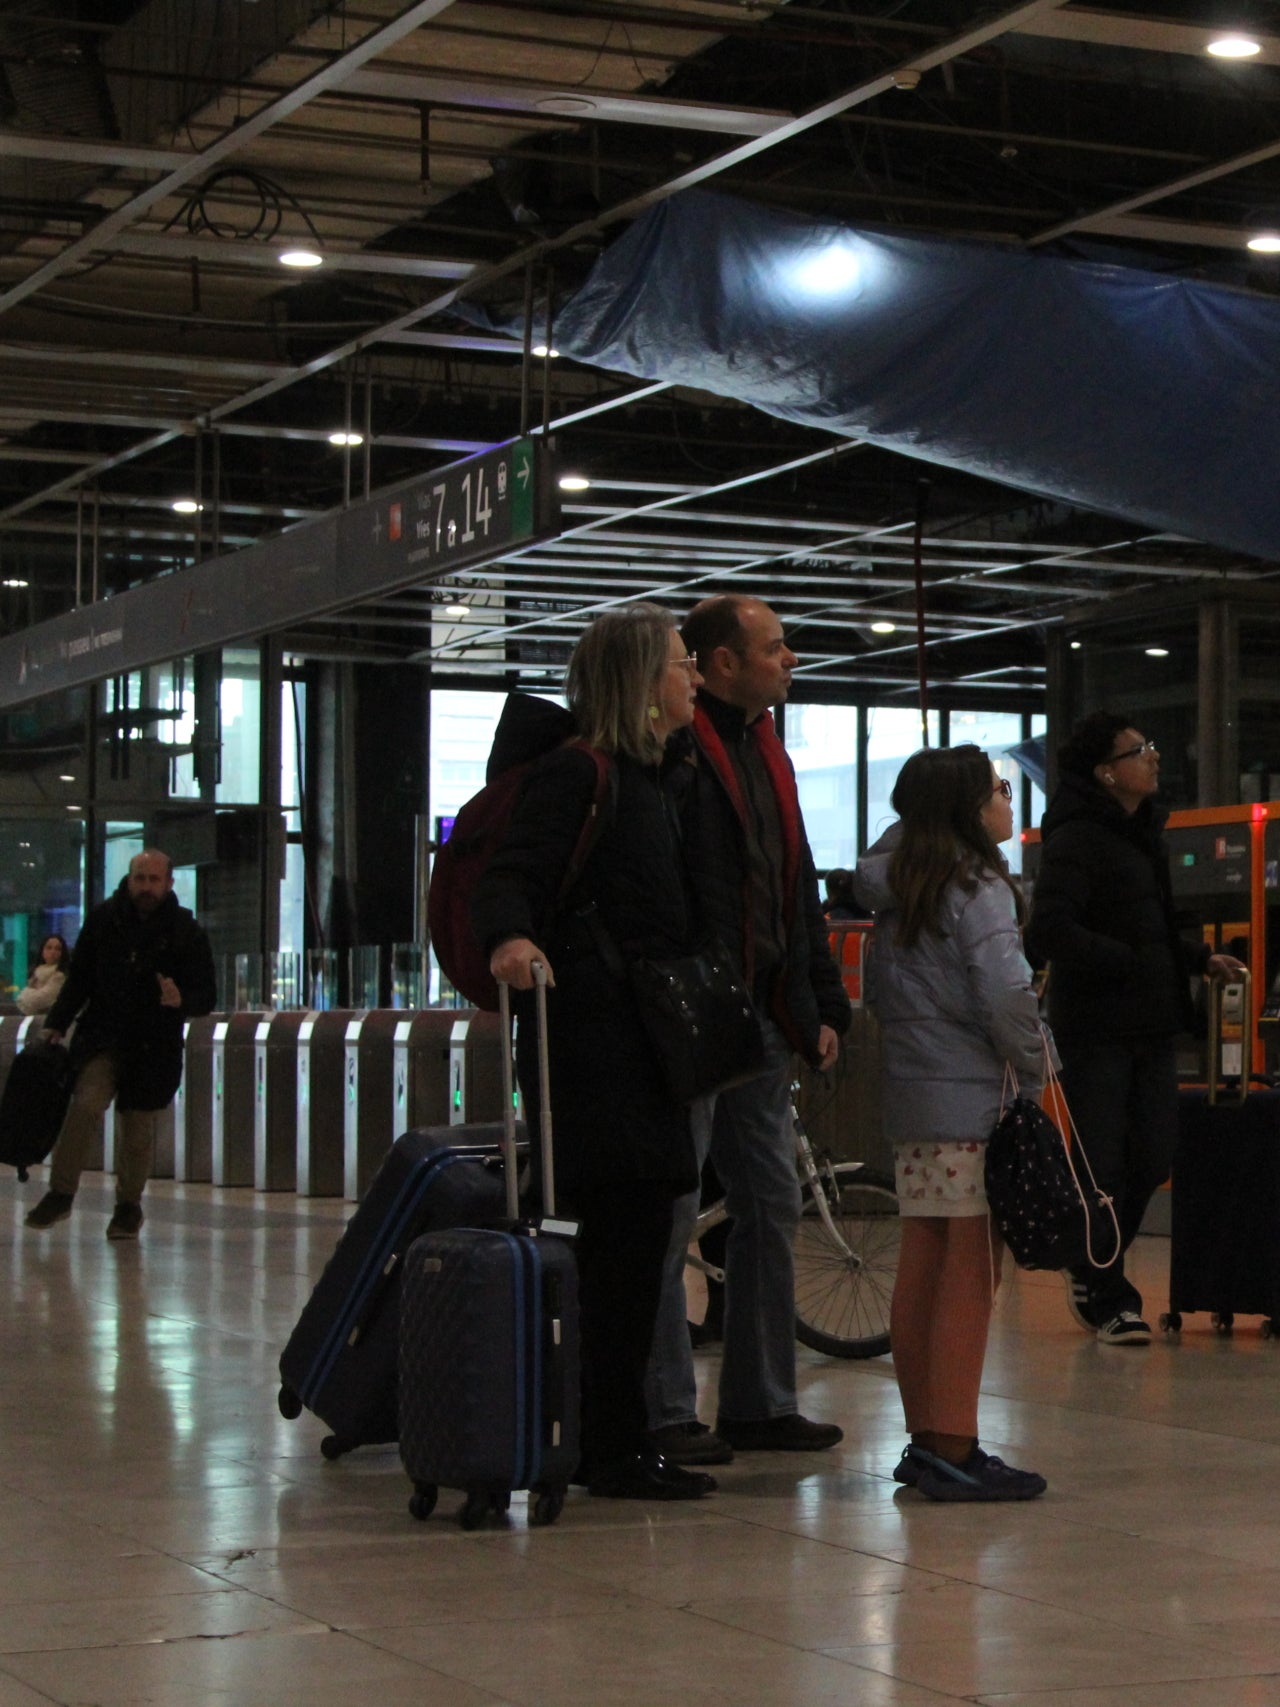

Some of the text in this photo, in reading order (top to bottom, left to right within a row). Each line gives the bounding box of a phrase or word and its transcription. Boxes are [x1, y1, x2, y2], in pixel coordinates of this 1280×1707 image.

[433, 483, 446, 553] 7
[447, 518, 457, 549] a
[461, 467, 492, 544] 14
